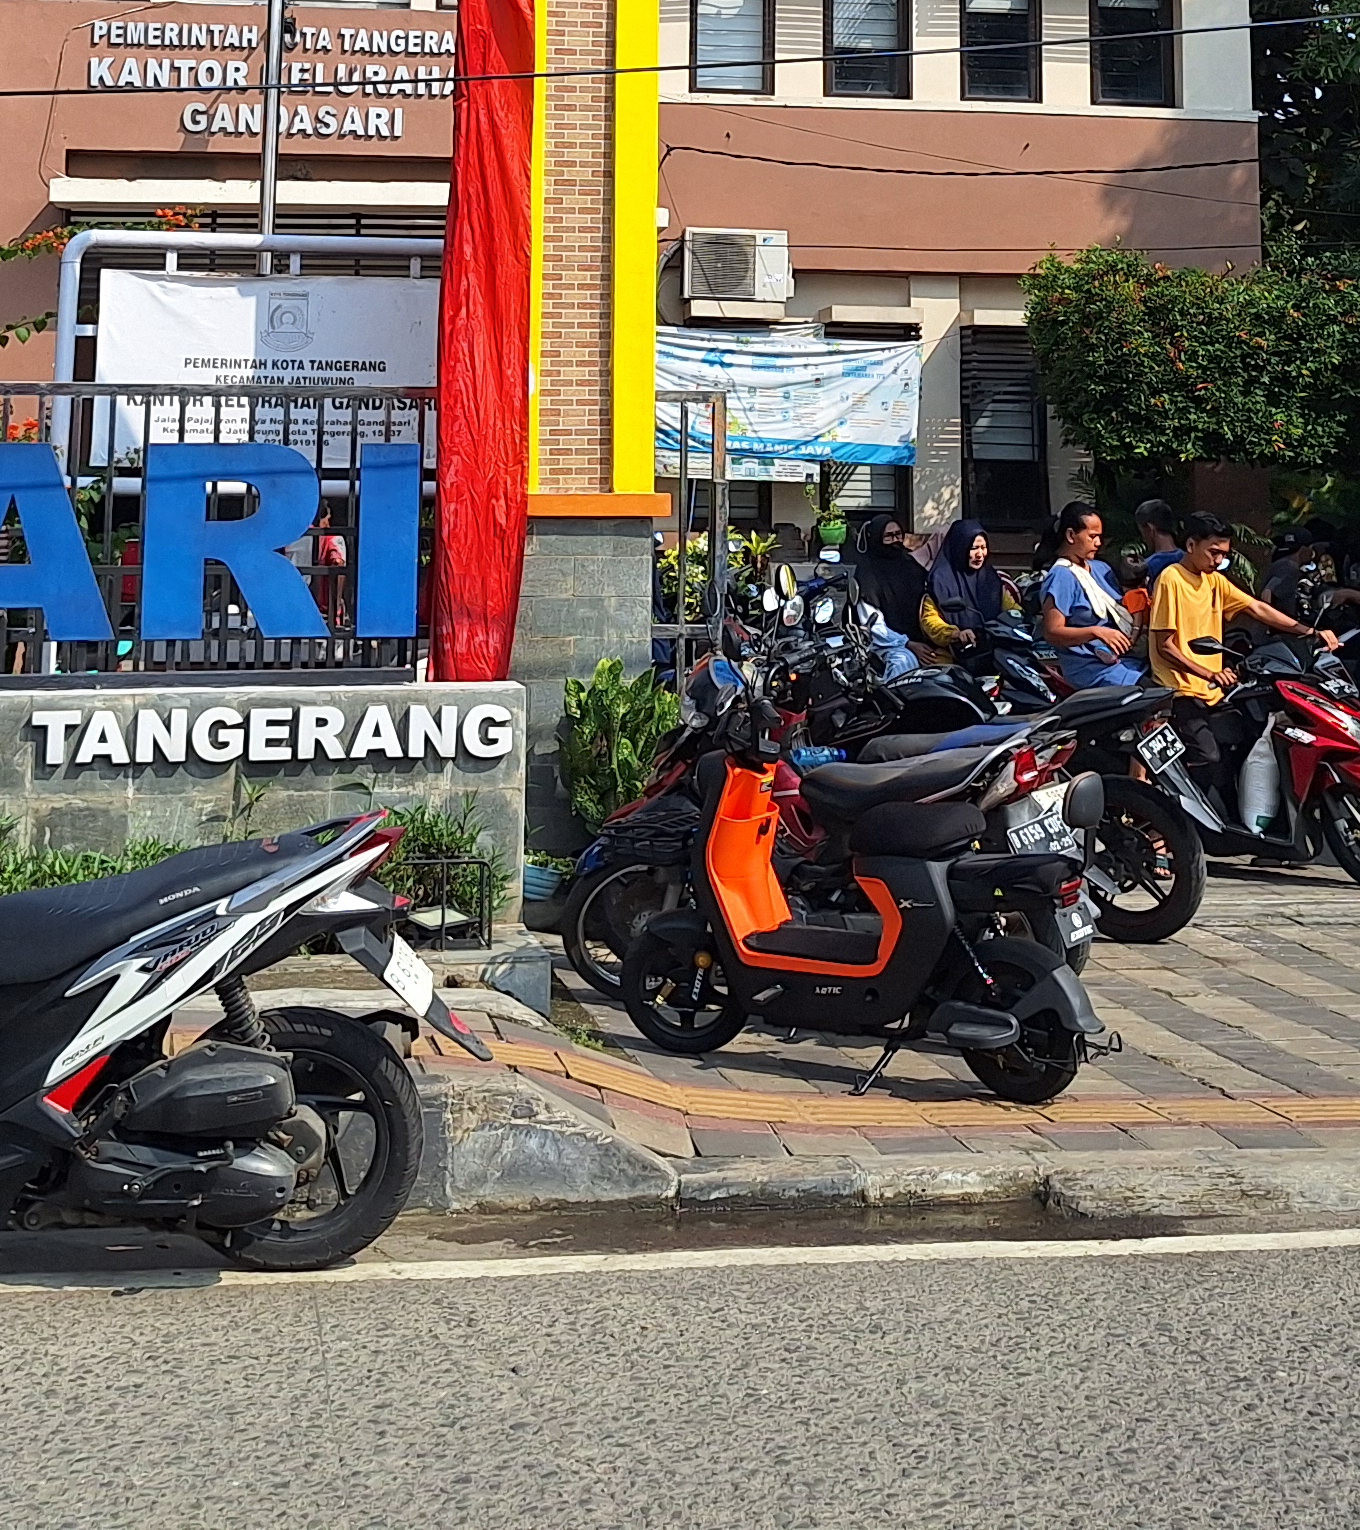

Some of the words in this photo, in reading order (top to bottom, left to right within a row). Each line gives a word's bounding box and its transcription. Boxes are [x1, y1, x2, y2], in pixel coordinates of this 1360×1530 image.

[93, 21, 258, 48] PEMERINTAH
[340, 28, 455, 53] TANGERA
[90, 56, 249, 88] KANTOR
[280, 62, 455, 96] ELURAHA
[184, 357, 267, 370] PEMERINTAH
[272, 359, 305, 371] KOTA
[309, 360, 387, 372] TANGERANG
[215, 375, 285, 385] KECAMATAN
[288, 376, 355, 386] JATIUWUNG
[212, 396, 319, 409] ELRAHA
[187, 417, 237, 425] Pajajran
[241, 418, 268, 426] Rya
[358, 419, 411, 427] Gandsari
[311, 429, 368, 438] Tngerag,
[32, 703, 515, 766] TANGERANG
[158, 885, 201, 906] HONDA
